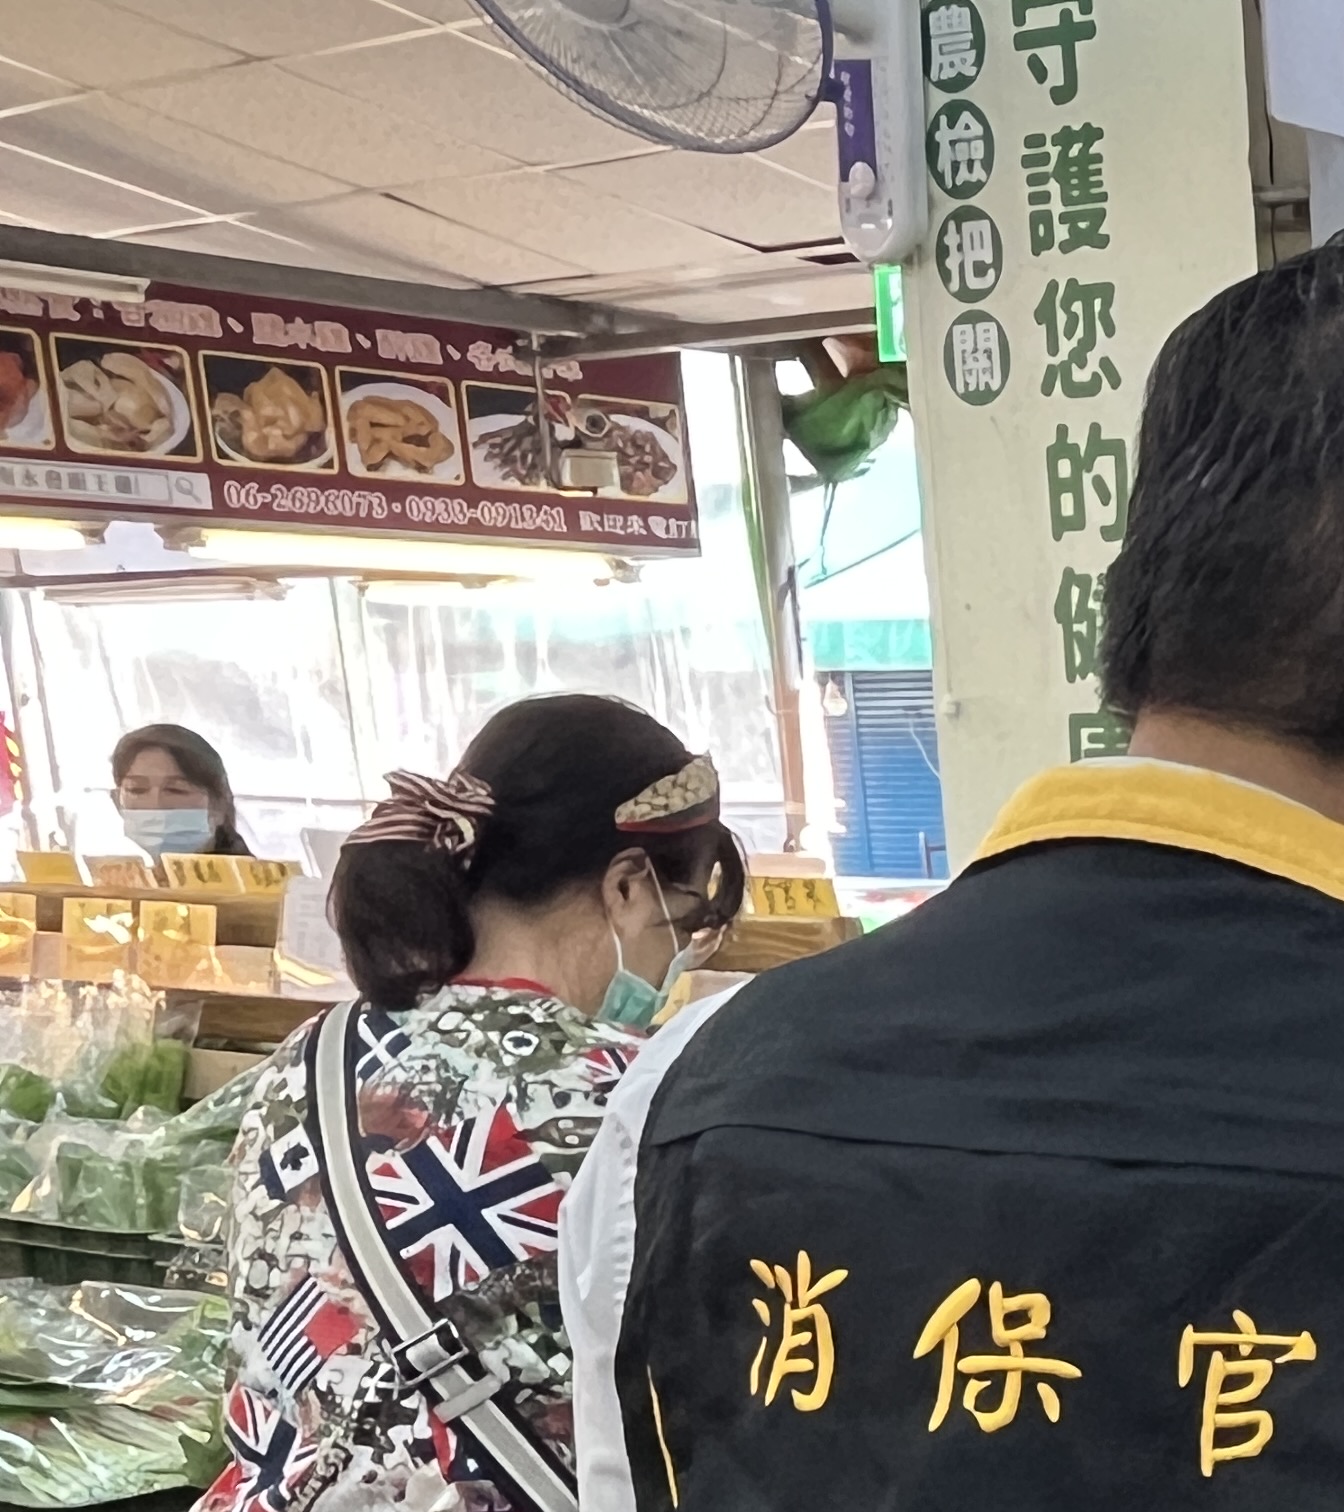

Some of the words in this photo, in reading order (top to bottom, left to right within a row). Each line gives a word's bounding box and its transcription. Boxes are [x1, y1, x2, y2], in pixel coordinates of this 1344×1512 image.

[926, 4, 1000, 396] 農檢把關
[749, 1249, 1317, 1477] 消保官
